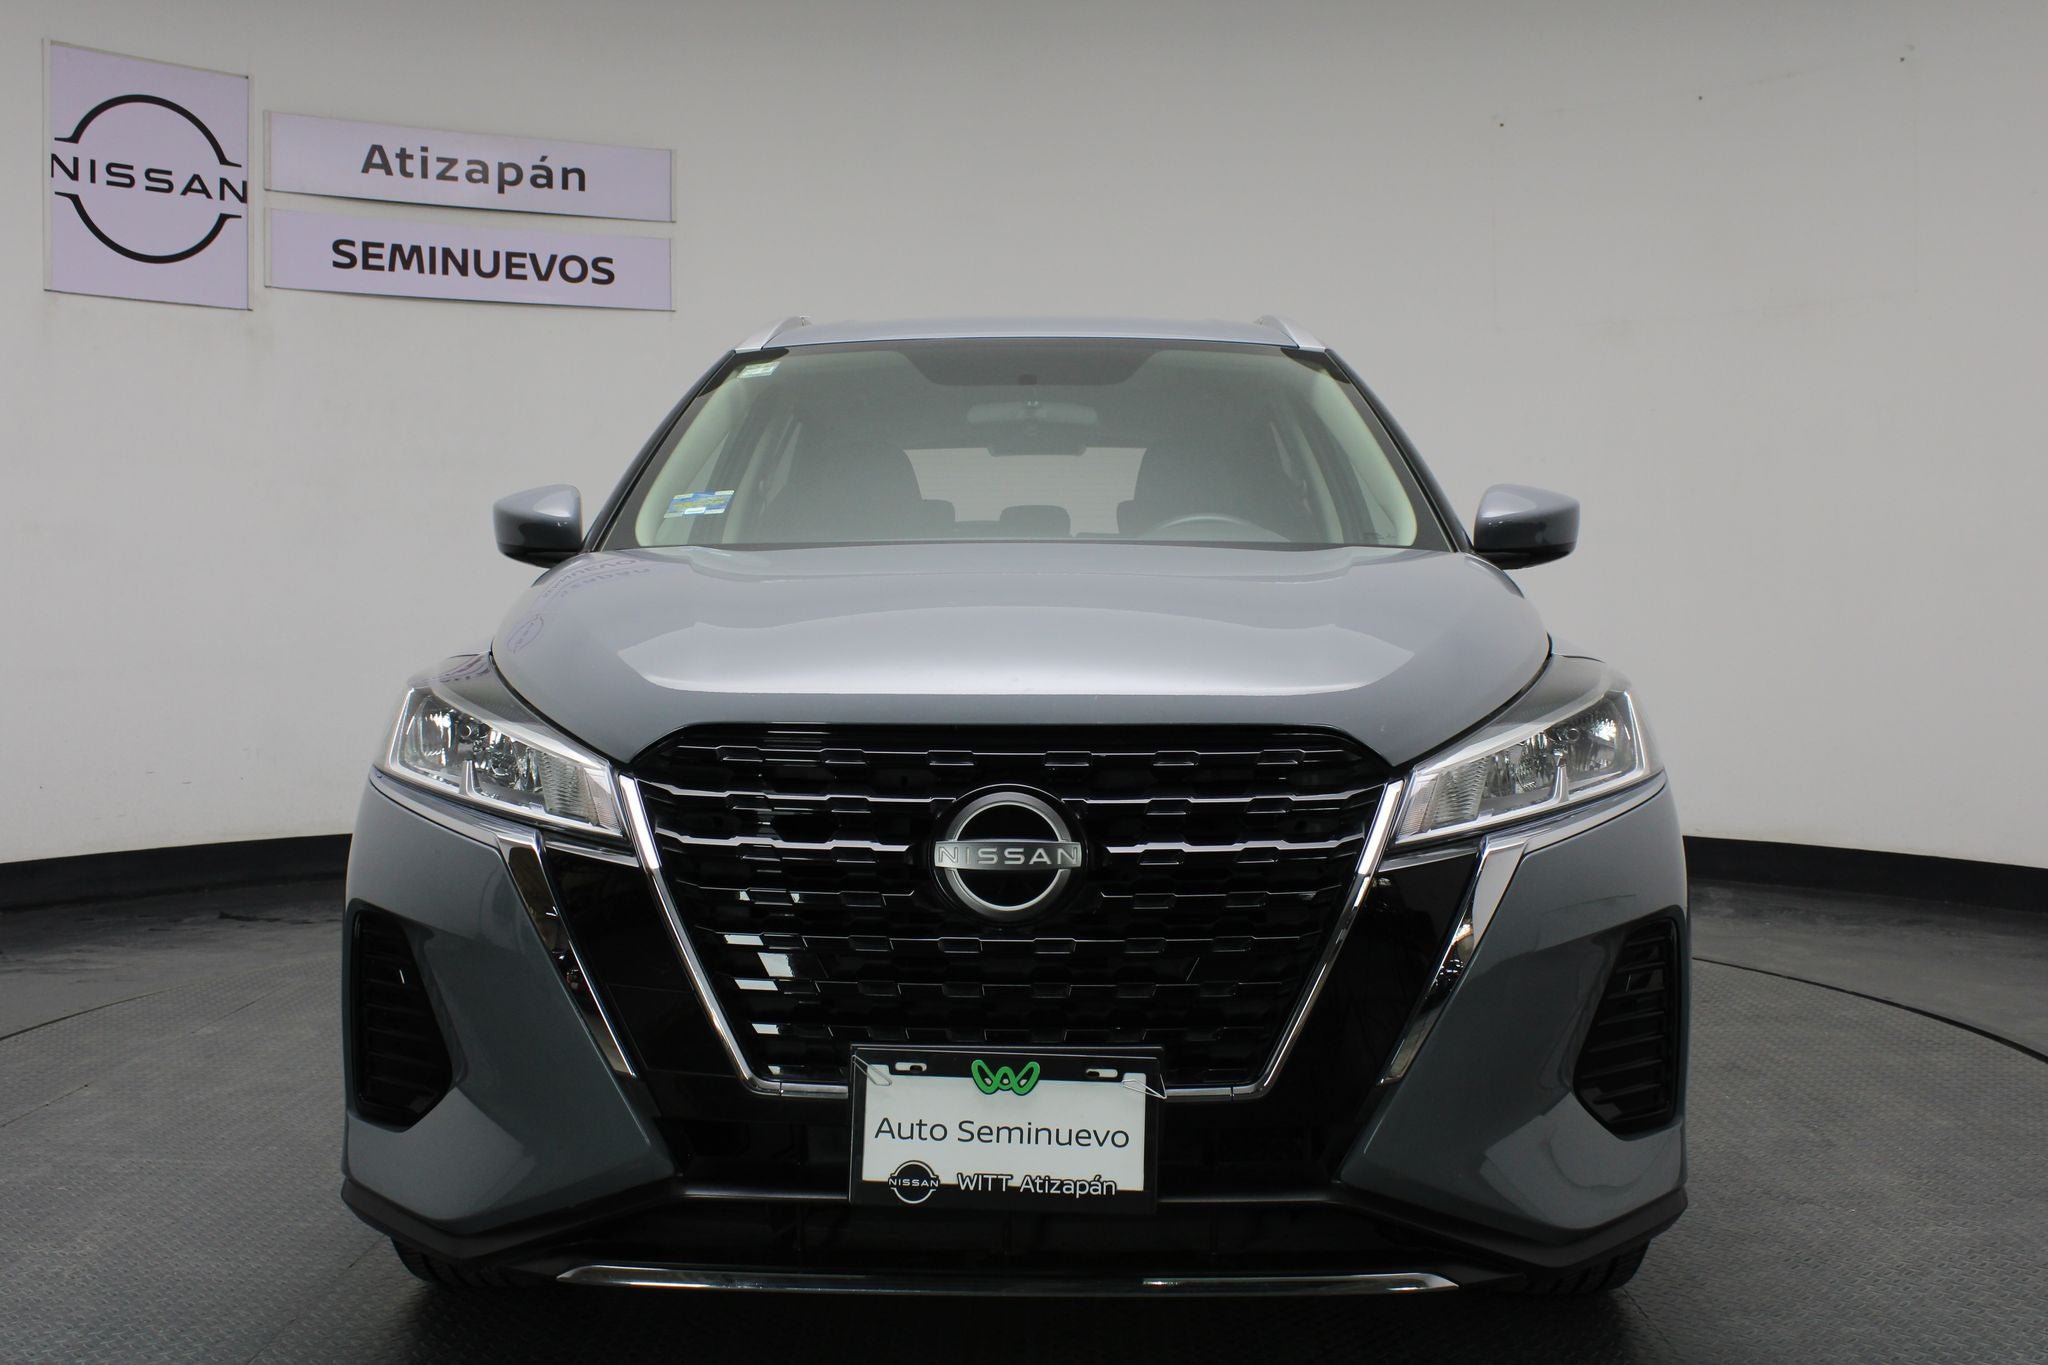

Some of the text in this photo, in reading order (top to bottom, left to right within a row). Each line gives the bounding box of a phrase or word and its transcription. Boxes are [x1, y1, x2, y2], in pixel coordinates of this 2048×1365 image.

[51, 153, 247, 204] NISSAN
[360, 143, 586, 194] Atizapán
[331, 238, 616, 285] SEMINUEVOS
[938, 847, 1078, 866] NISSAN
[874, 1117, 1130, 1148] Auto Seminuevo
[888, 1177, 940, 1188] NISSAN
[957, 1173, 1117, 1198] WITT Atizapán
